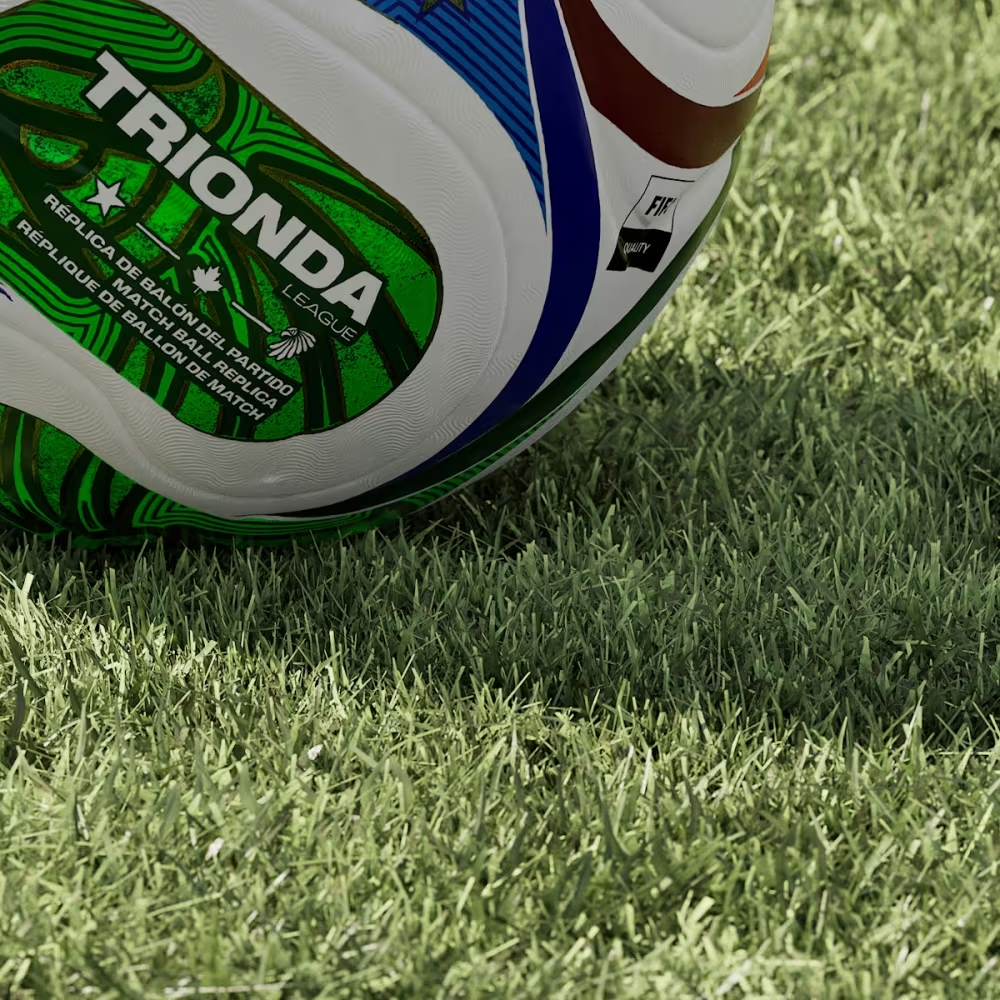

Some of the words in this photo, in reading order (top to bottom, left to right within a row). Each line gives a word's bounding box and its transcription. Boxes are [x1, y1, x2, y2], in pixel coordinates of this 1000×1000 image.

[85, 49, 384, 326] TRIONDA
[623, 242, 652, 255] QUALITY
[644, 195, 677, 217] FIF
[16, 219, 100, 300] RÉPLIQUE
[98, 290, 122, 316] DE
[120, 308, 188, 366] BALLON
[185, 360, 209, 385] DE
[206, 379, 265, 422] MATCH
[43, 193, 115, 260] RÉPLICA
[115, 254, 140, 279] DE
[139, 271, 199, 330] BALÓN
[196, 315, 226, 350] DEL
[225, 343, 294, 397] PARTIDO
[112, 277, 173, 332] MATCH
[170, 322, 214, 363] BALL
[212, 354, 279, 409] REPLICA
[281, 283, 358, 342] LEAGUE
